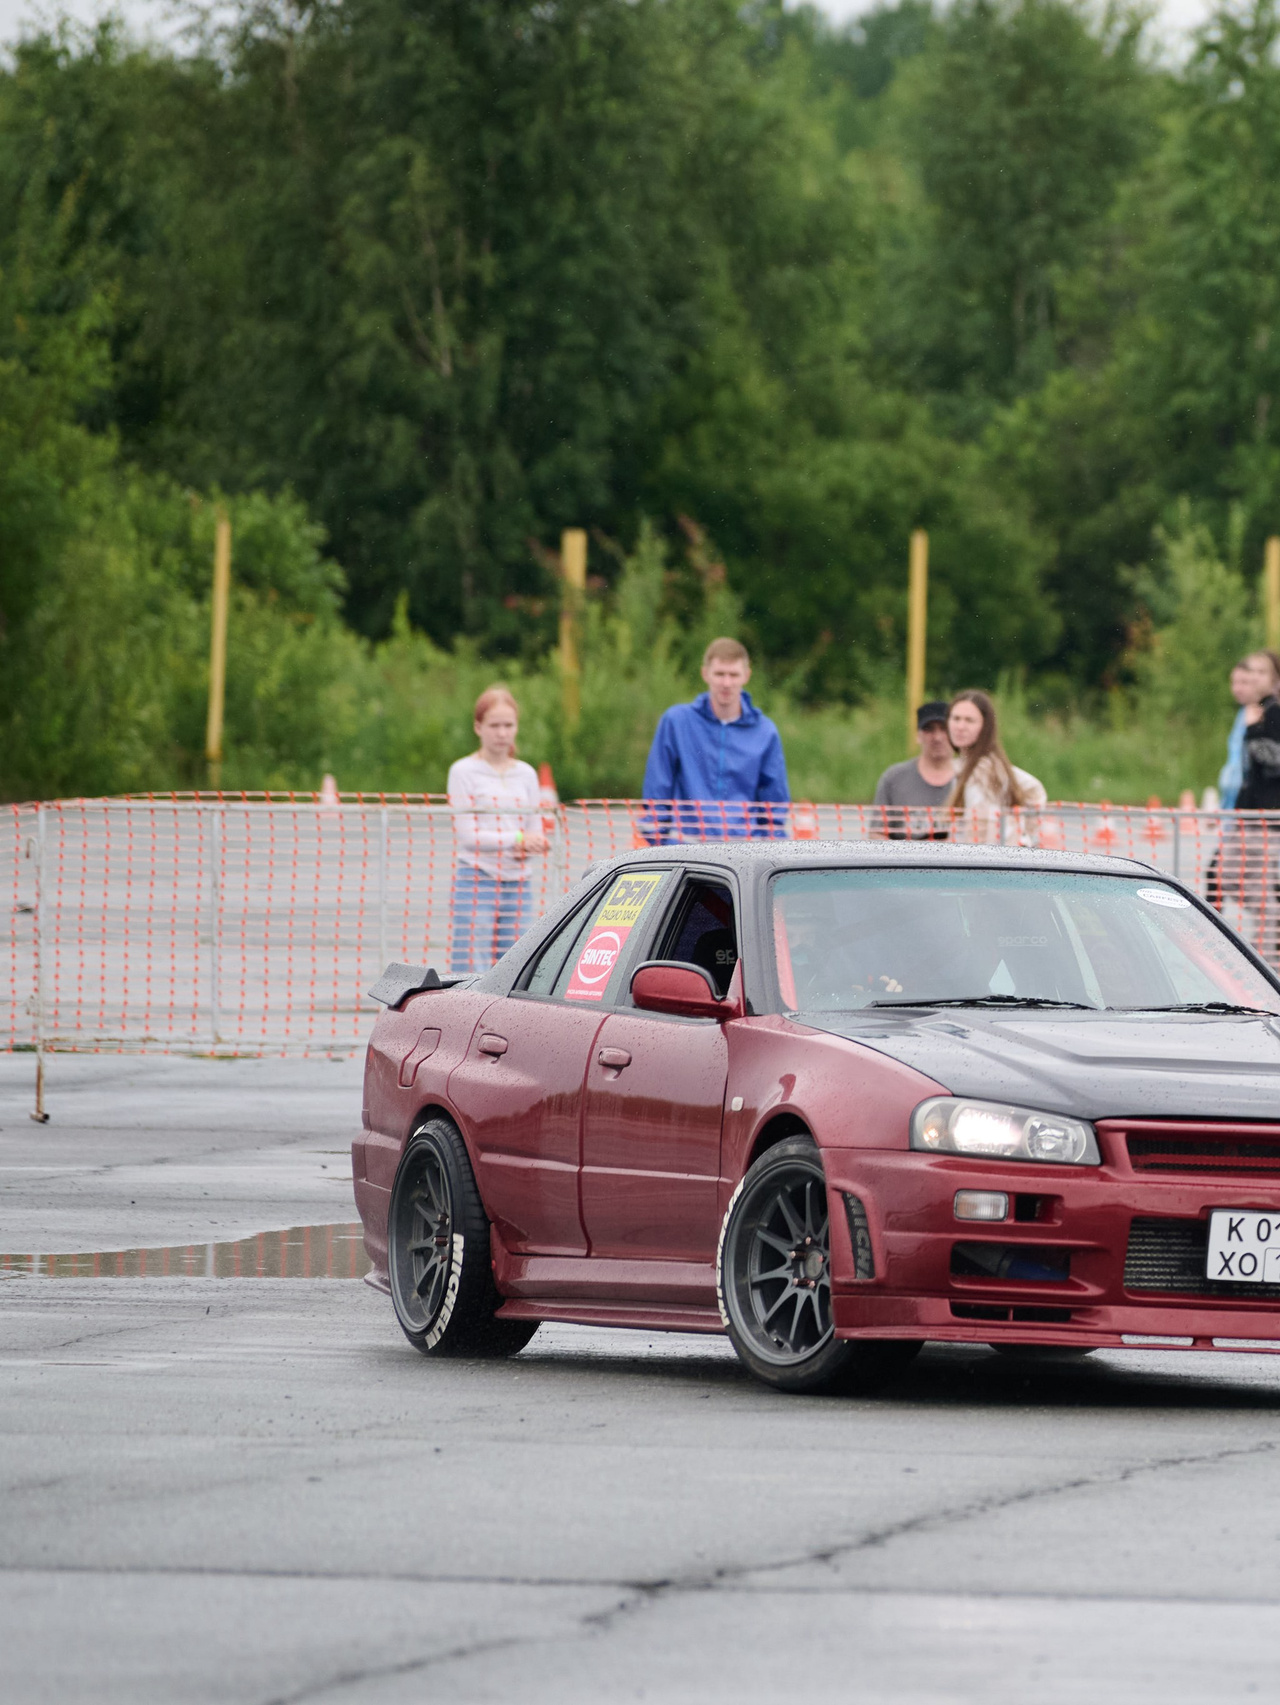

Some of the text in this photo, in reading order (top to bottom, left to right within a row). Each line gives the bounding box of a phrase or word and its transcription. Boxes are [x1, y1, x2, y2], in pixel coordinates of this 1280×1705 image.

[581, 949, 616, 966] SINTEC
[1227, 1217, 1246, 1242] К
[1217, 1251, 1258, 1277] ХО
[424, 1232, 465, 1350] MICHELIN
